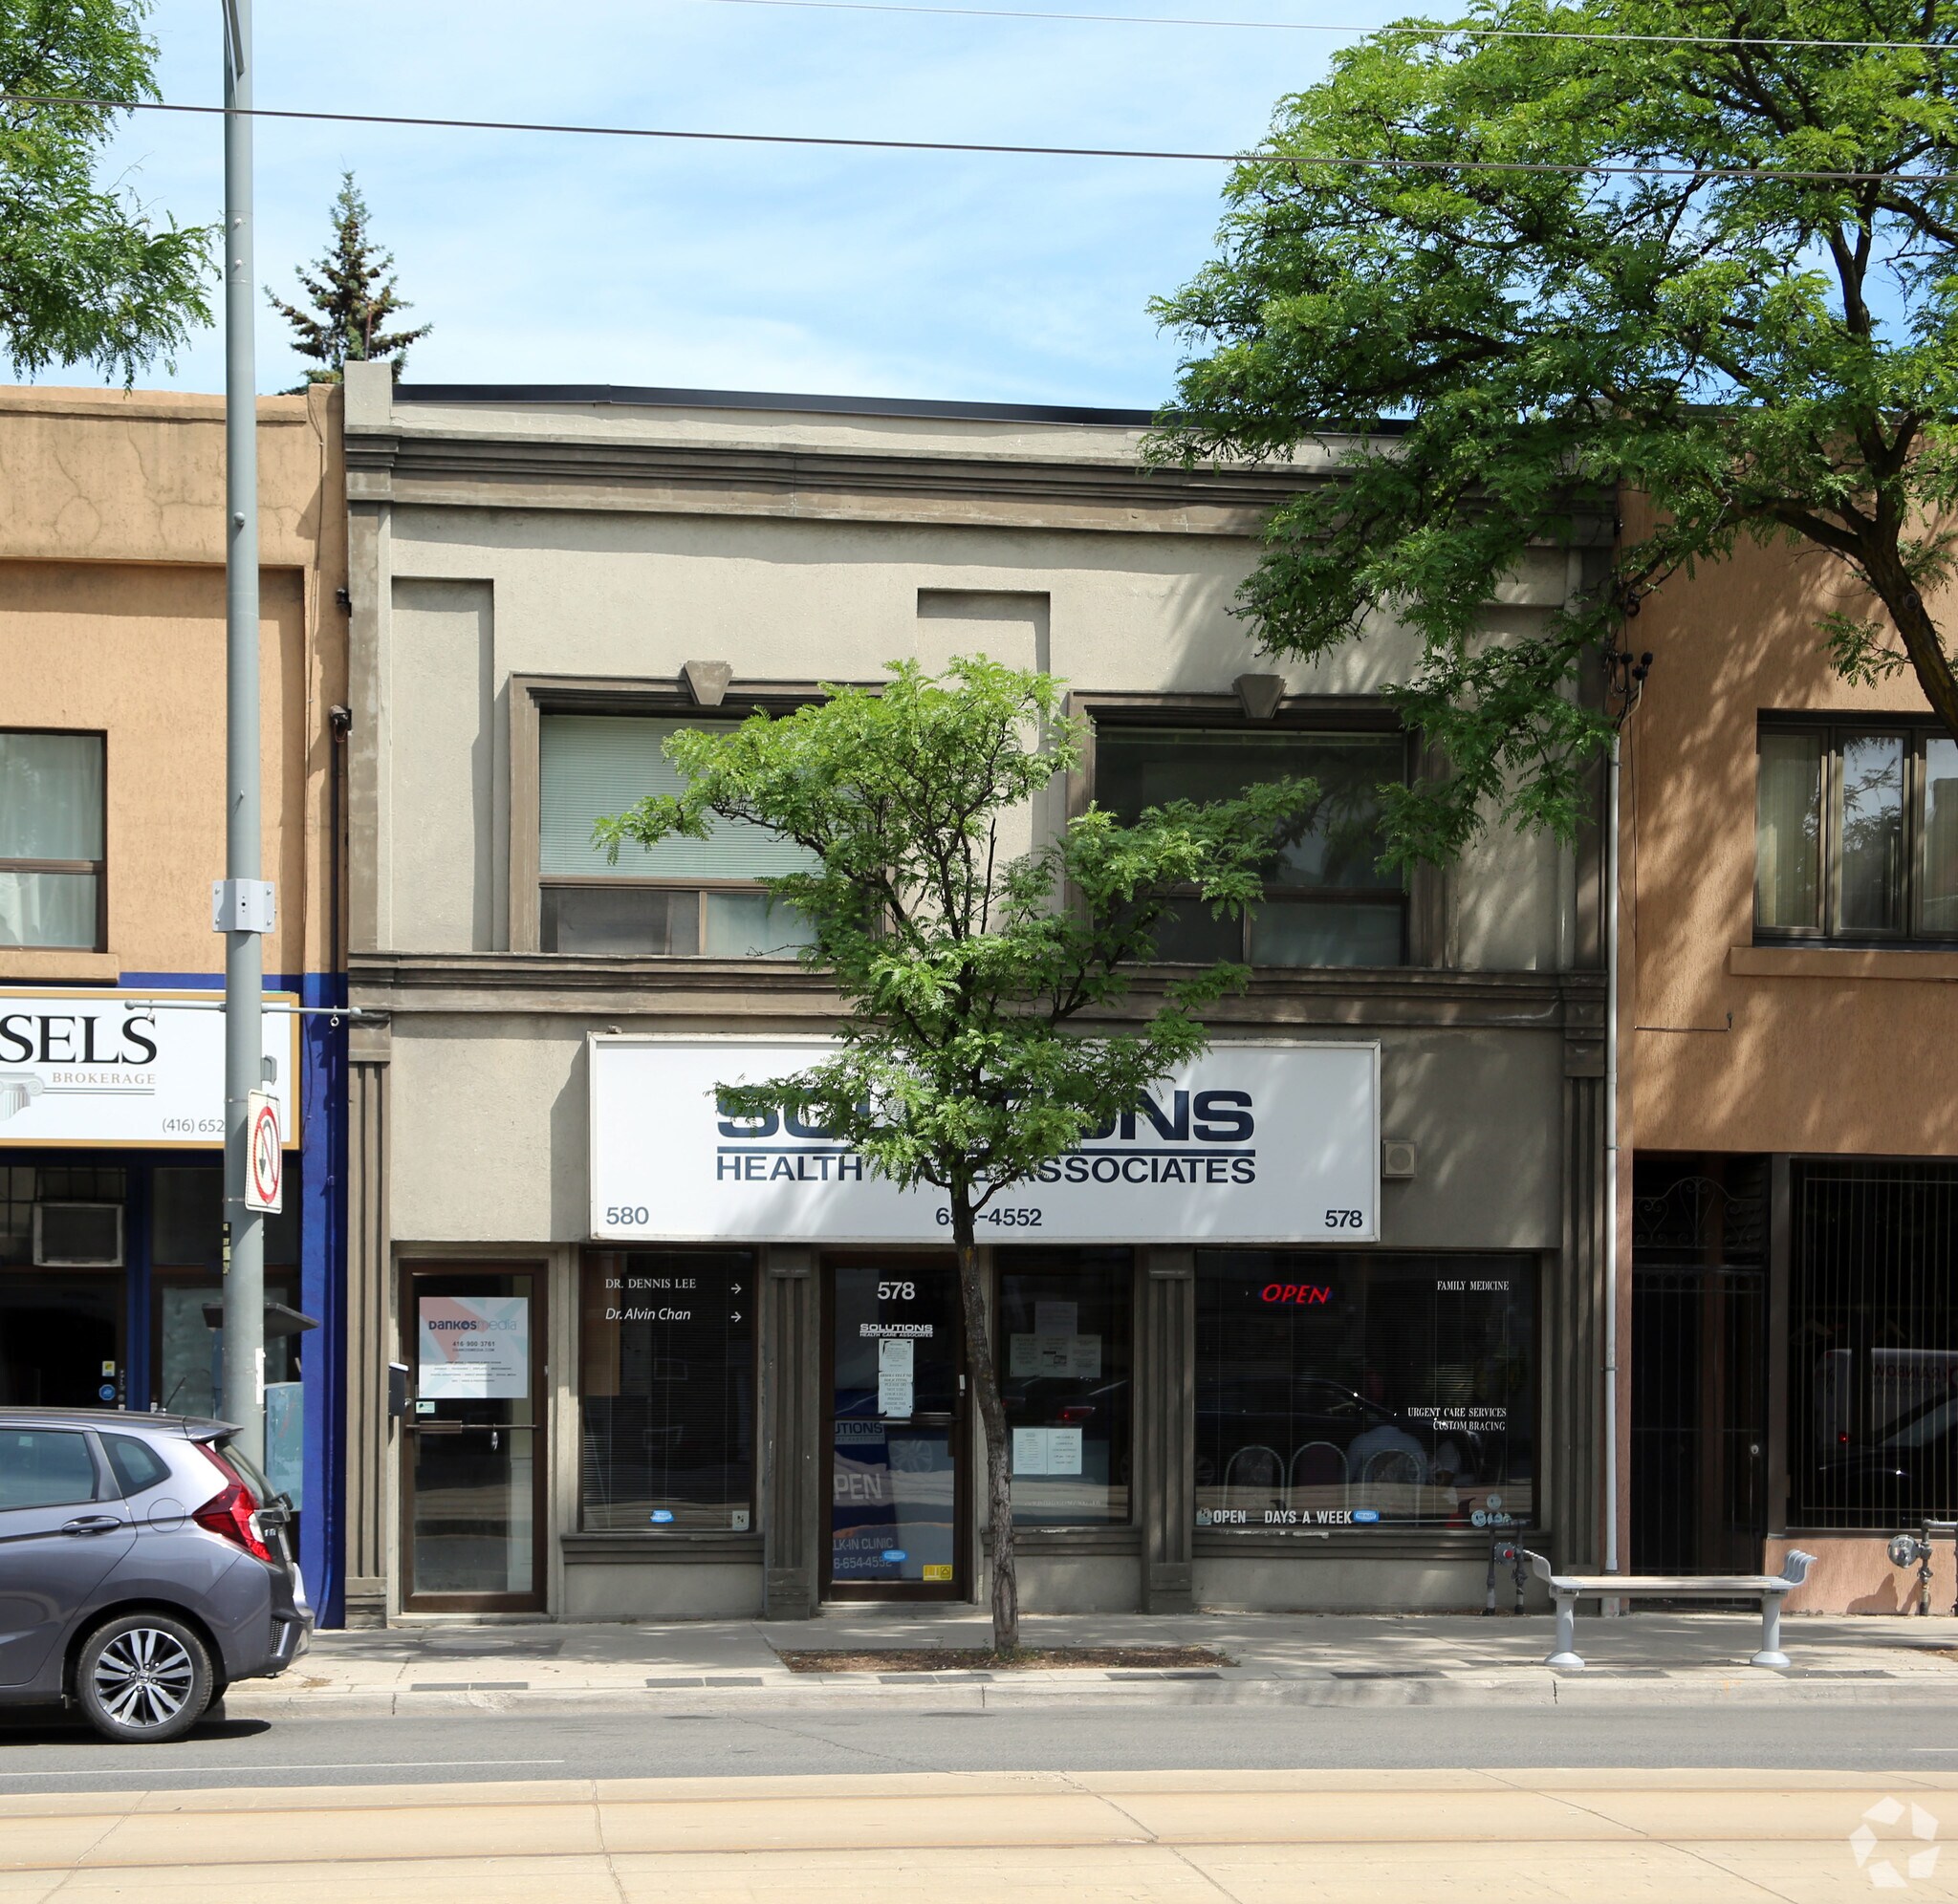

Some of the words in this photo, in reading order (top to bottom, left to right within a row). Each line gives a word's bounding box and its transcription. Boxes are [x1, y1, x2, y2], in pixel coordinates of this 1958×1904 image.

[52, 1072, 156, 1085] BROKERAGE
[163, 1118, 195, 1134] (416)
[716, 1155, 863, 1181] HEALTH
[605, 1206, 649, 1225] 580
[935, 1207, 1042, 1226] 6-4552
[1324, 1209, 1363, 1228] 578
[605, 1278, 623, 1289] DR.
[628, 1278, 671, 1289] DENNIS
[675, 1278, 697, 1288] LEE
[1437, 1281, 1466, 1291] FAMILY
[1469, 1281, 1510, 1291] MEDICINE
[877, 1281, 916, 1300] 578
[1261, 1284, 1330, 1305] OPEN
[605, 1308, 622, 1320] Dr.
[623, 1308, 656, 1320] Alvin
[658, 1308, 691, 1320] Chan
[859, 1323, 933, 1331] SOLUTIONS
[1407, 1407, 1441, 1417] URGENT
[1444, 1407, 1466, 1417] CARE
[1468, 1407, 1507, 1417] SERVICES
[1468, 1420, 1506, 1431] BRACING
[1213, 1510, 1247, 1524] OPEN
[1264, 1510, 1296, 1524] DAYS
[1302, 1510, 1311, 1524] A
[1316, 1510, 1353, 1525] WEEK
[861, 1537, 894, 1549] CLINIC
